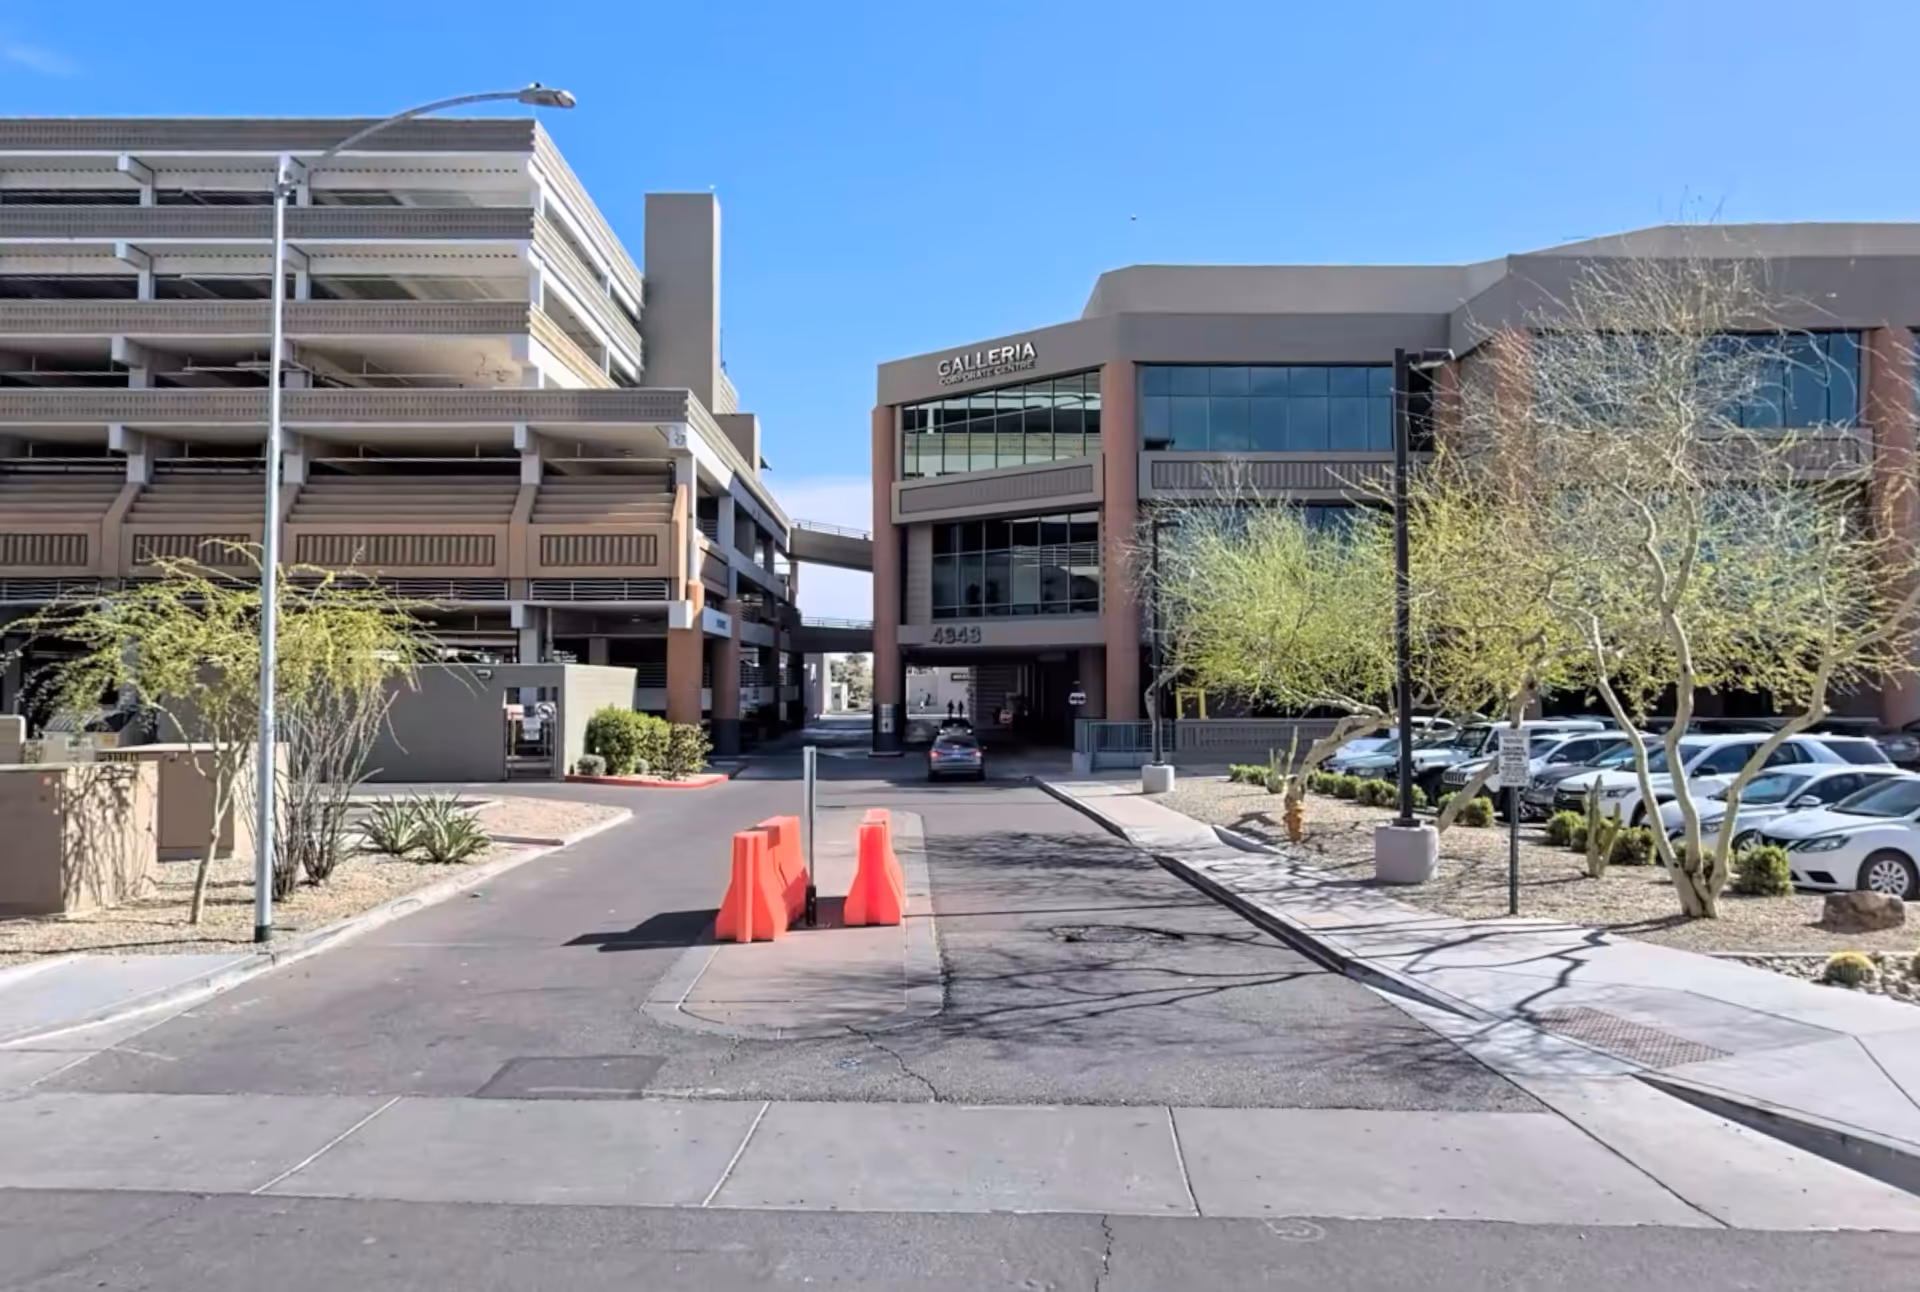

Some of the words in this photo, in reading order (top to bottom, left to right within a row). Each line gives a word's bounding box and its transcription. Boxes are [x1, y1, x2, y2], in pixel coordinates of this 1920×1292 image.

[938, 342, 1037, 377] GALLERIA
[995, 360, 1036, 376] CENTRE
[931, 626, 981, 644] 4343
